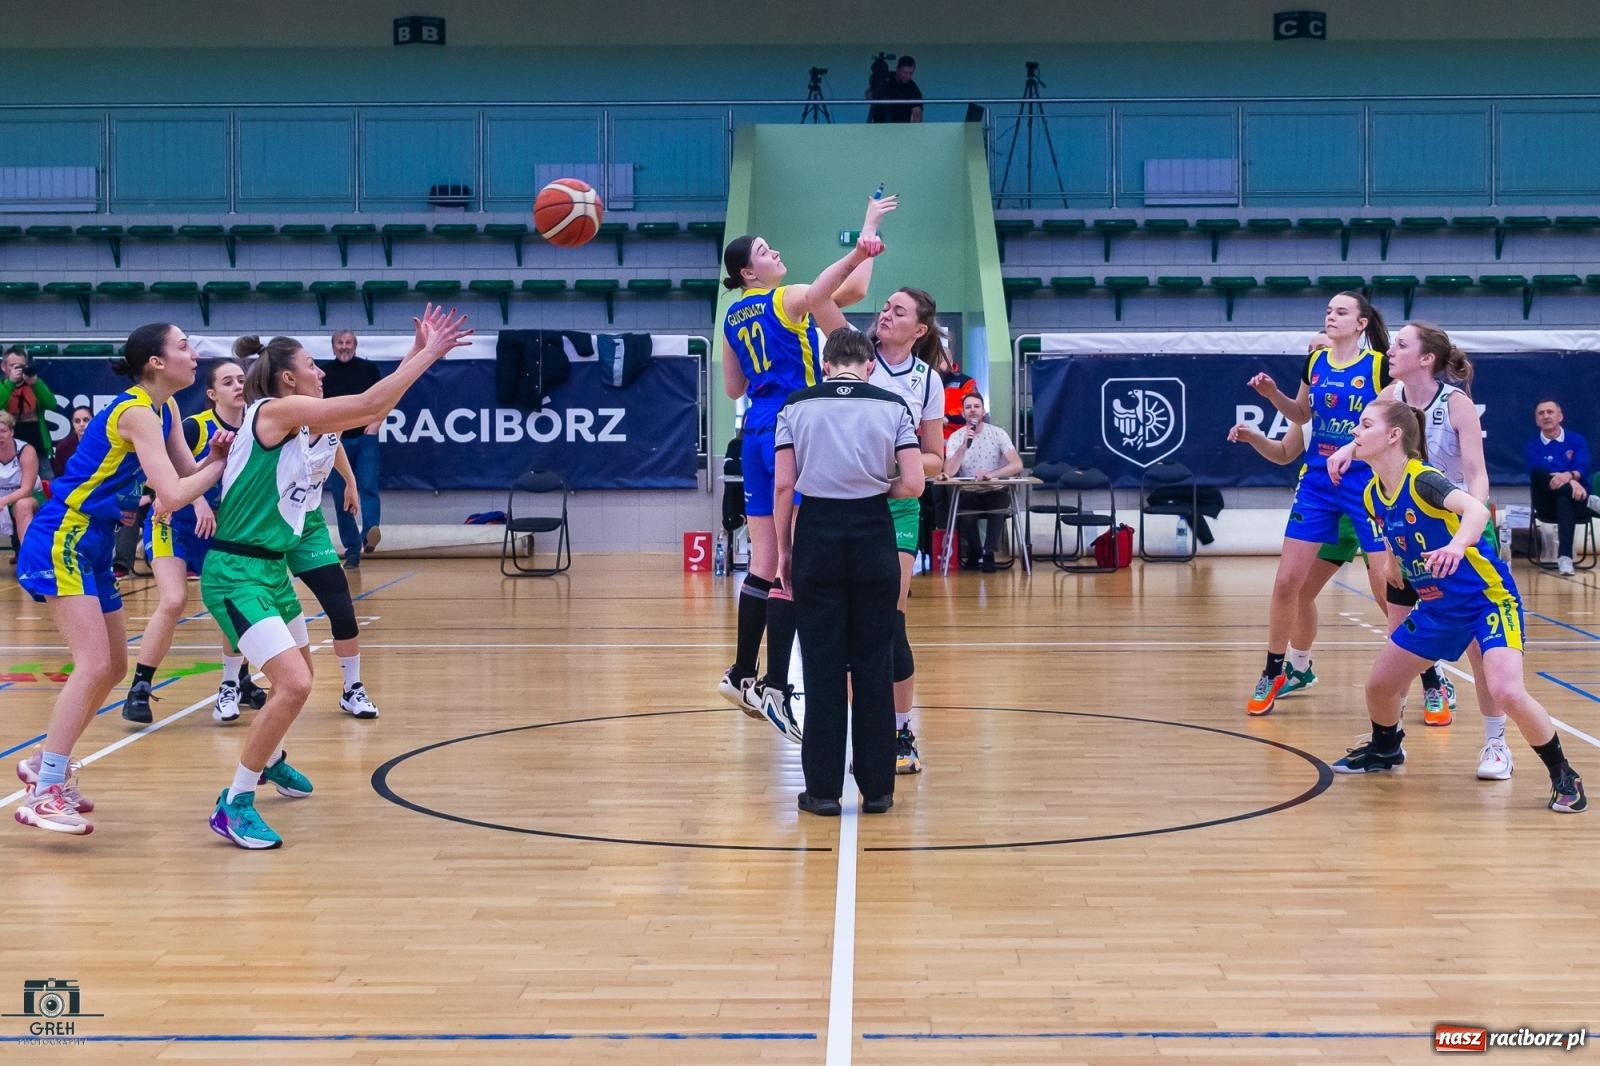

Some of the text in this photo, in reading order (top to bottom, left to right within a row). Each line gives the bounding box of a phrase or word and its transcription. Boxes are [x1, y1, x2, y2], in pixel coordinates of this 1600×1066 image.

[398, 26, 411, 42] B
[422, 25, 440, 41] B
[1279, 20, 1298, 36] C
[1309, 20, 1323, 36] C
[1348, 394, 1363, 412] 14
[377, 397, 628, 443] RACIBÓRZ
[1432, 407, 1446, 426] 9
[688, 535, 707, 564] 5
[1414, 531, 1427, 551] 9
[1485, 612, 1500, 635] 9
